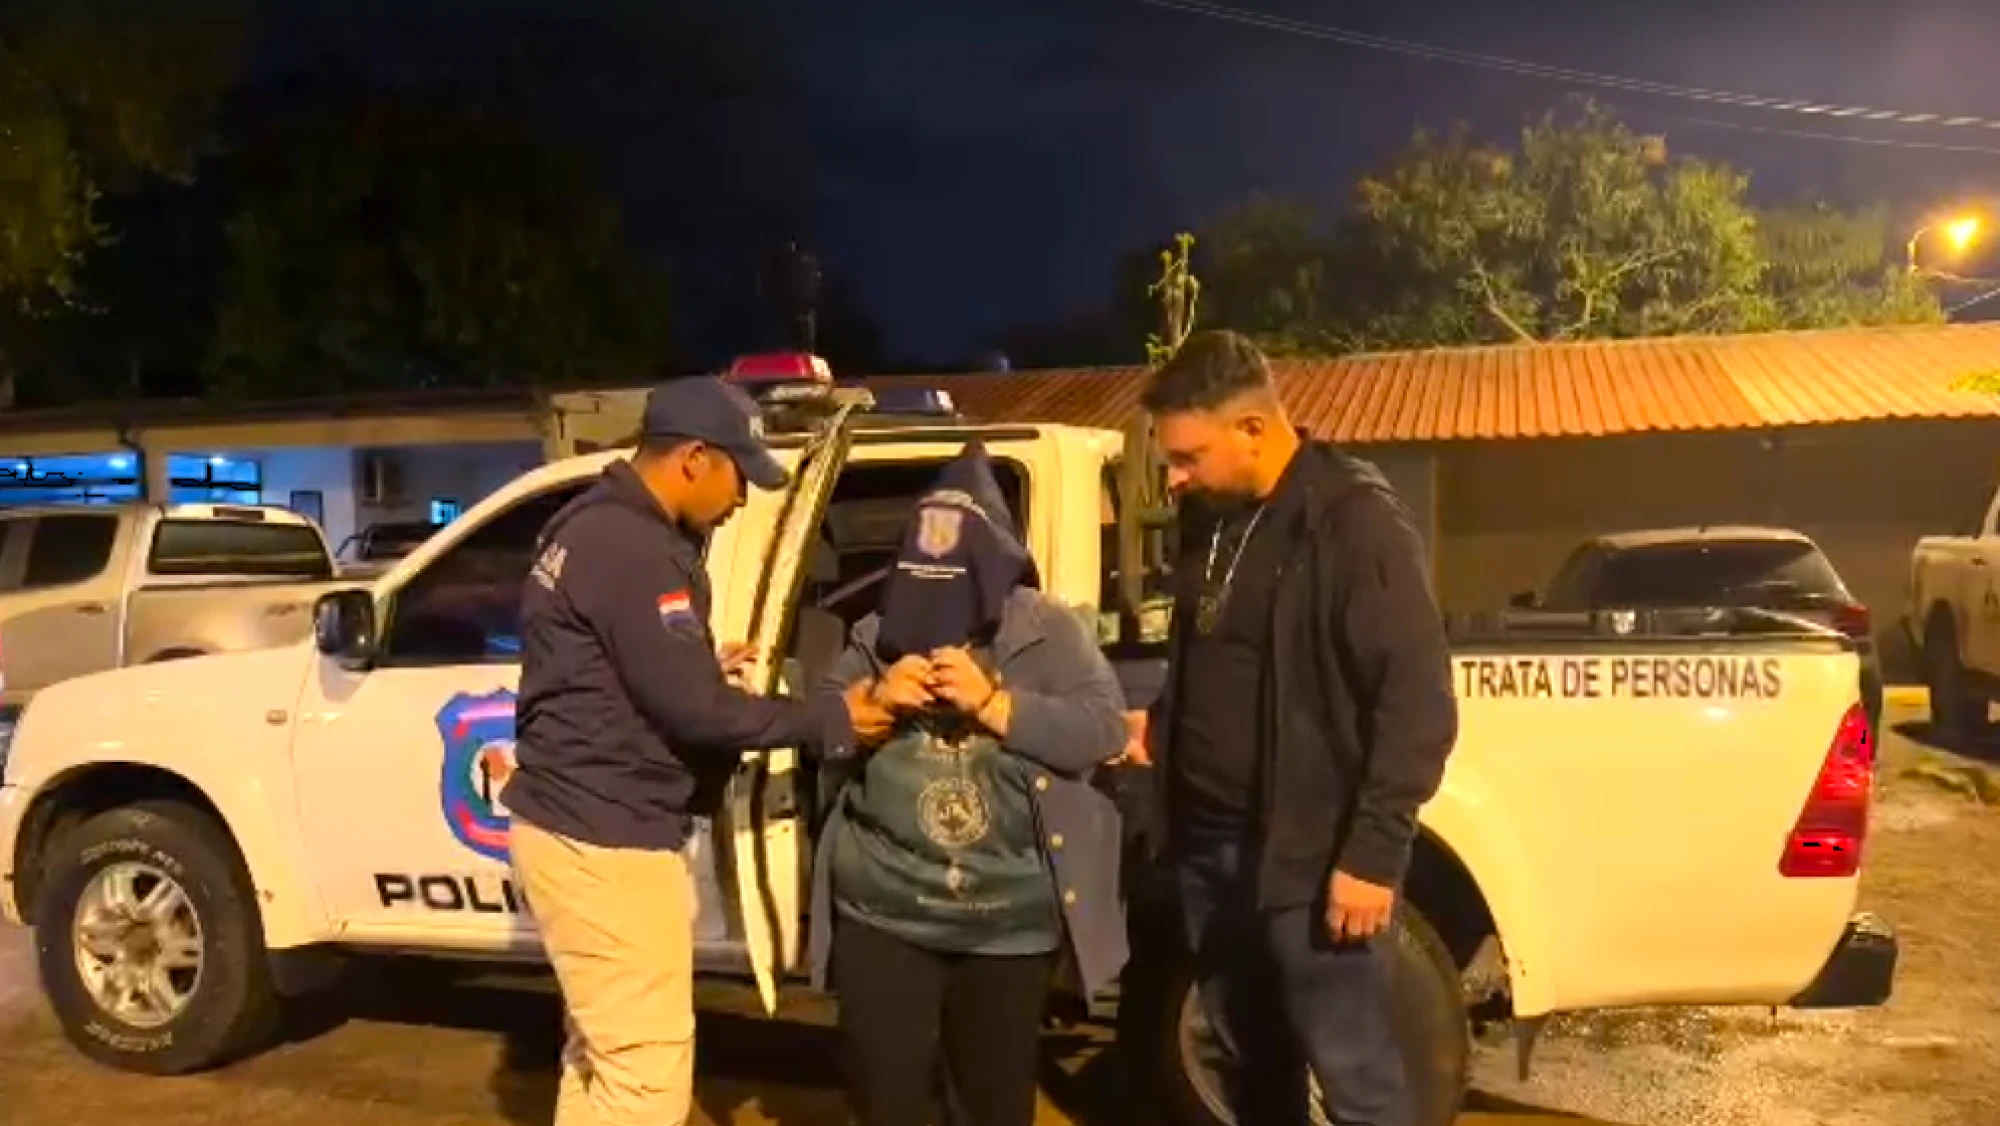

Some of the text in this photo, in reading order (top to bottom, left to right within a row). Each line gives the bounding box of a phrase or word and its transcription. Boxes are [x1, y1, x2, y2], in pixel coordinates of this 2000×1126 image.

[1461, 660, 1780, 698] TRATA DE PERSONAS
[374, 873, 523, 915] POLI
